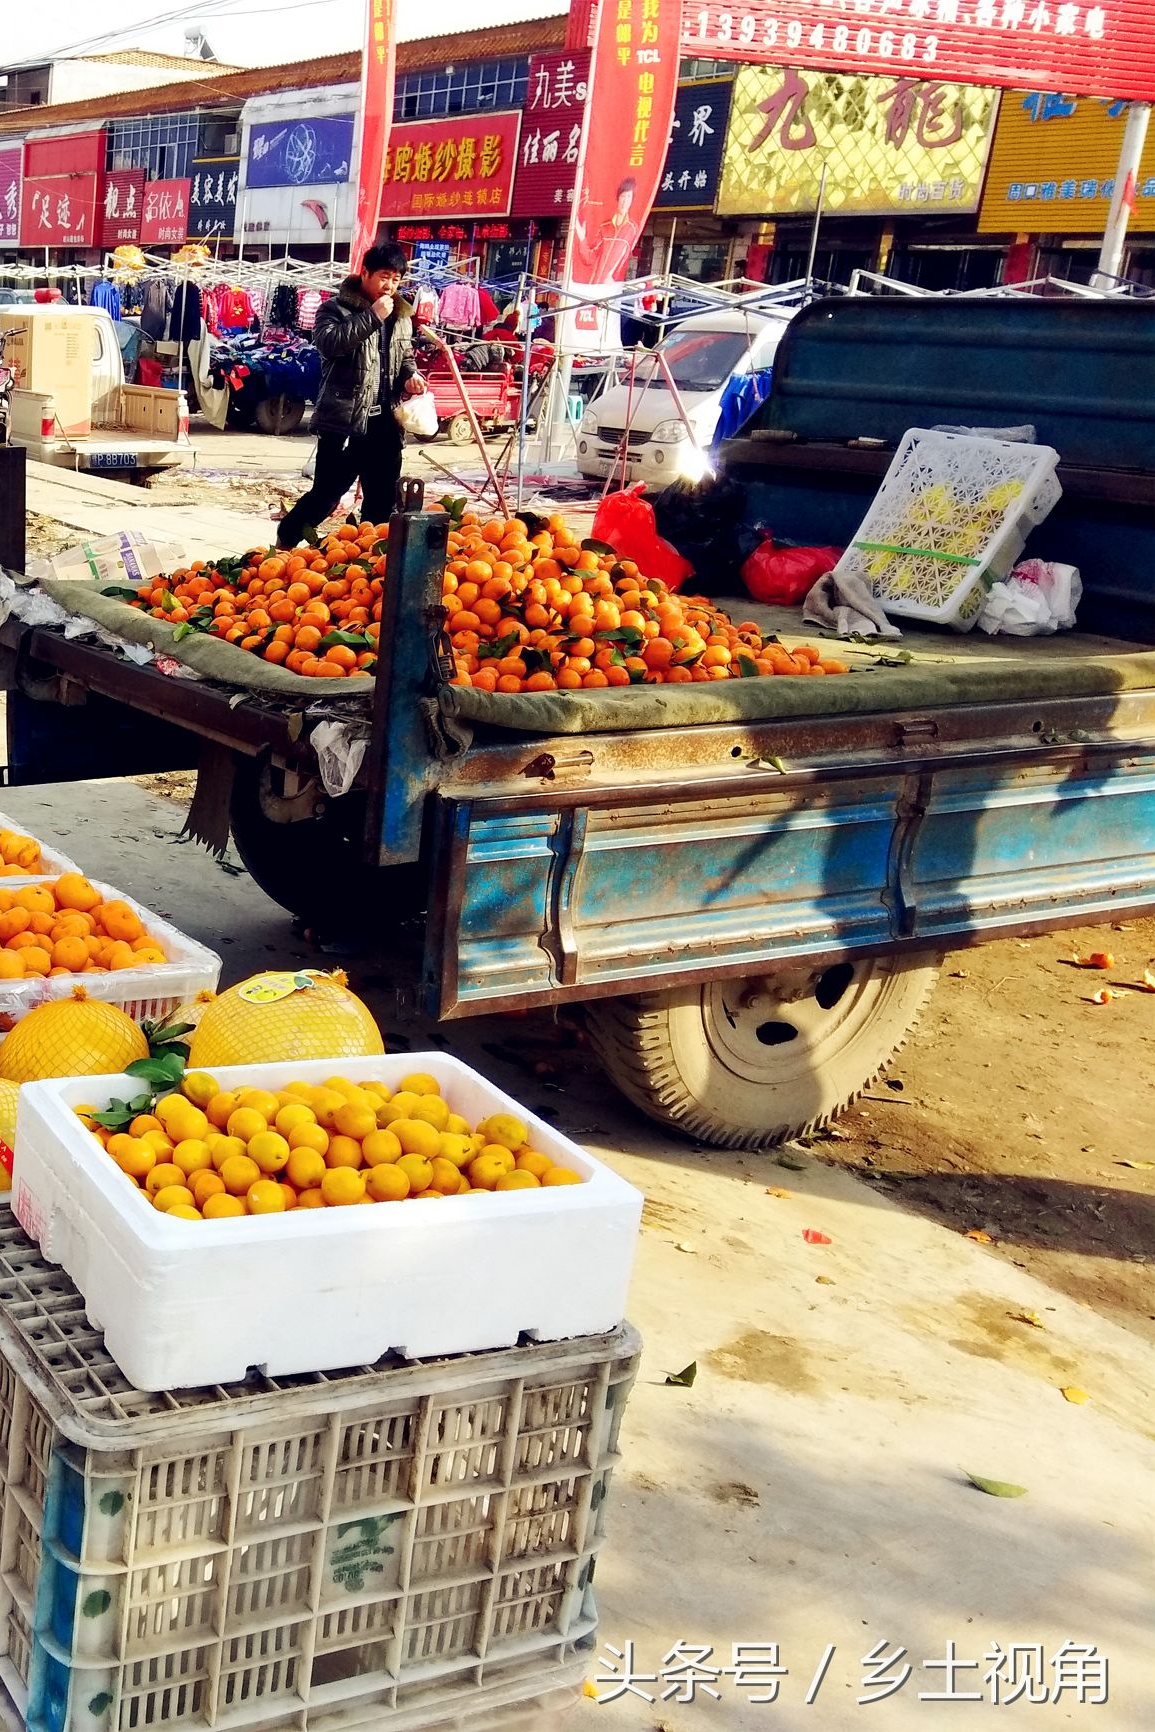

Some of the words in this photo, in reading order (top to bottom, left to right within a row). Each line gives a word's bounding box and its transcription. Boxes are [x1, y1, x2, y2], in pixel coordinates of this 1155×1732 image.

[412, 188, 503, 209] 国际婚纱连锁店
[899, 178, 965, 202] 时尚百货
[1007, 177, 1155, 201] 周口雅美瑞化品
[158, 227, 184, 240] 时尚女装
